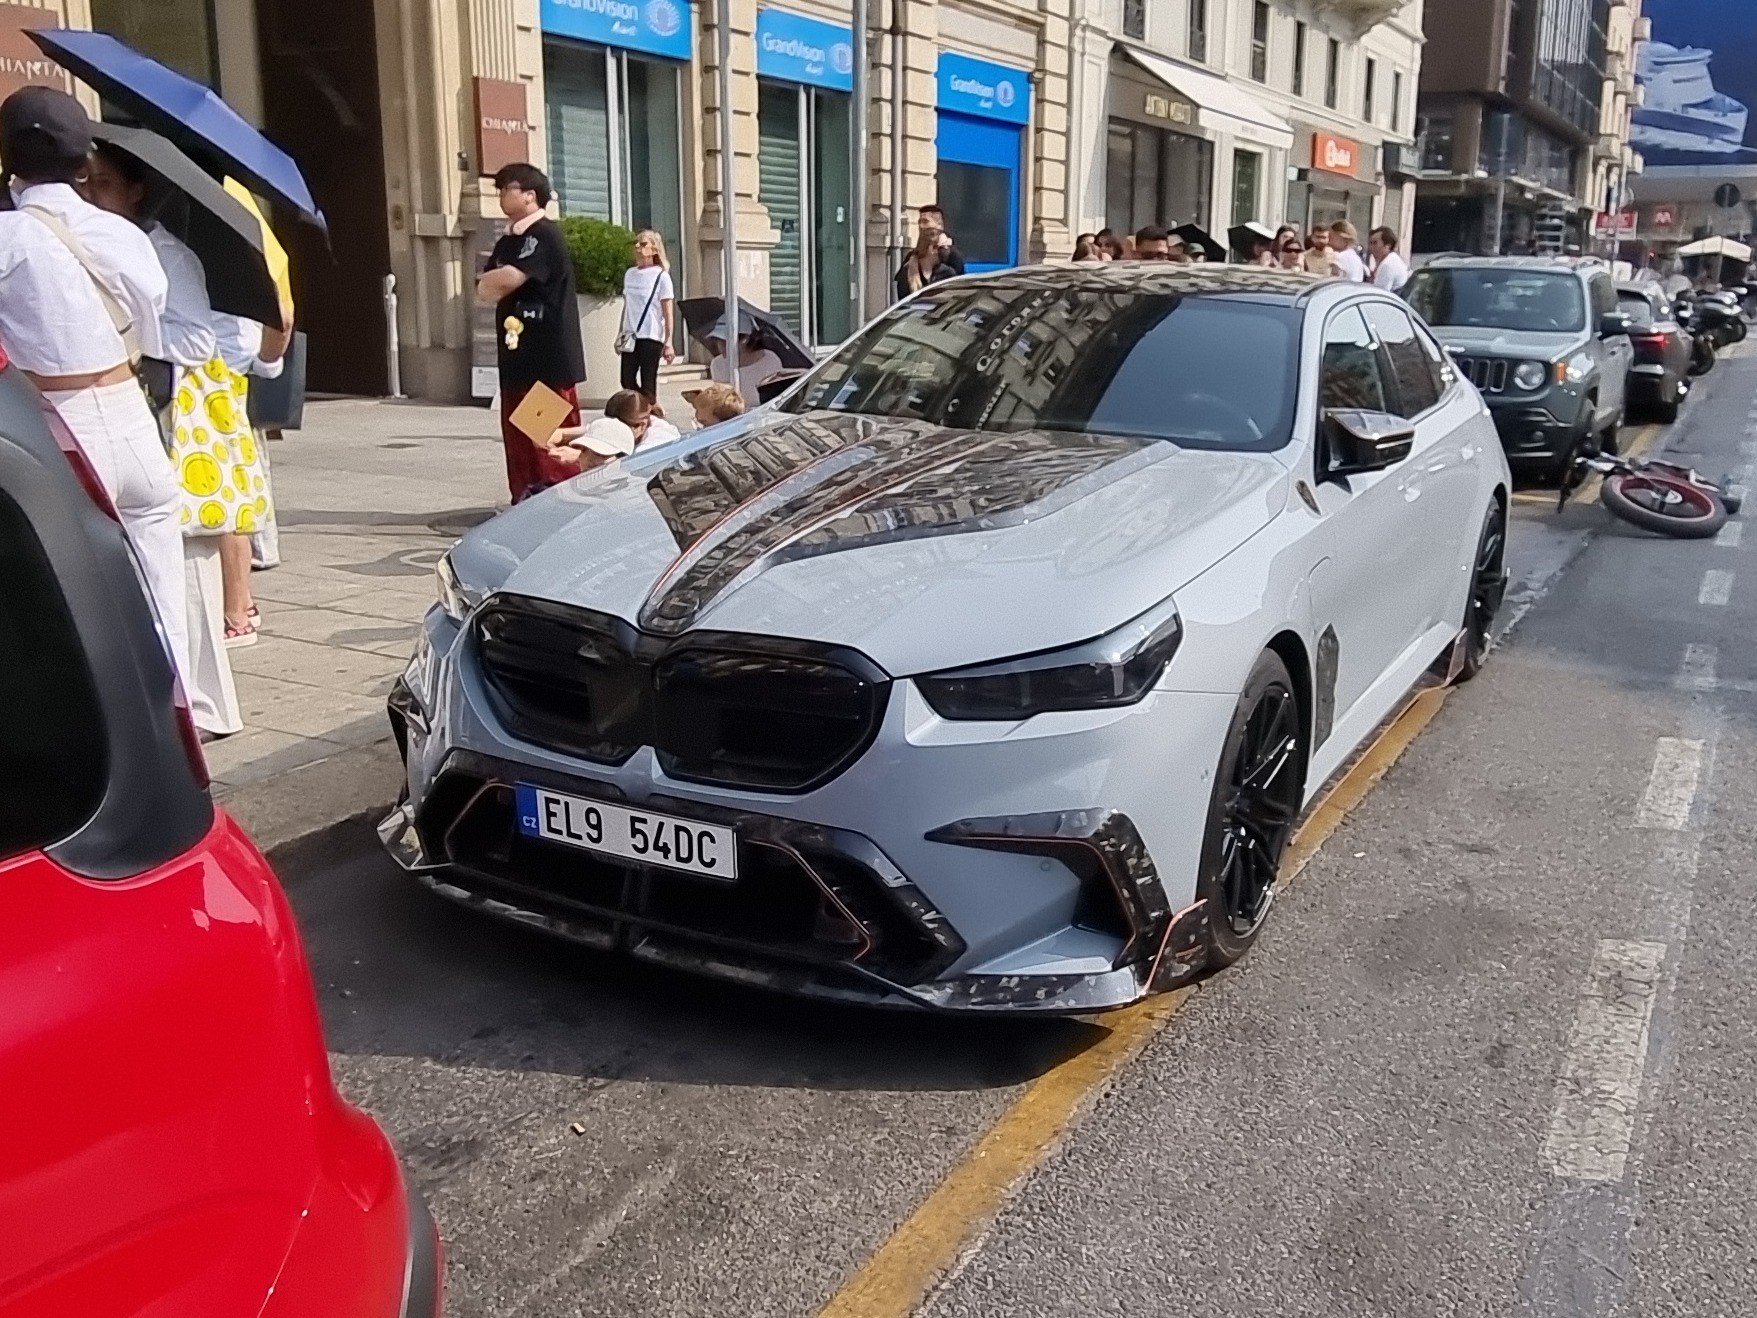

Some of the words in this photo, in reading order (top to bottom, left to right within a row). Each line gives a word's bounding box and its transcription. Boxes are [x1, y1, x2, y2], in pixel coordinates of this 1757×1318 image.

[554, 0, 639, 20] randVision
[522, 815, 537, 829] CZ
[544, 796, 603, 844] EL9
[630, 815, 717, 868] 54DC
